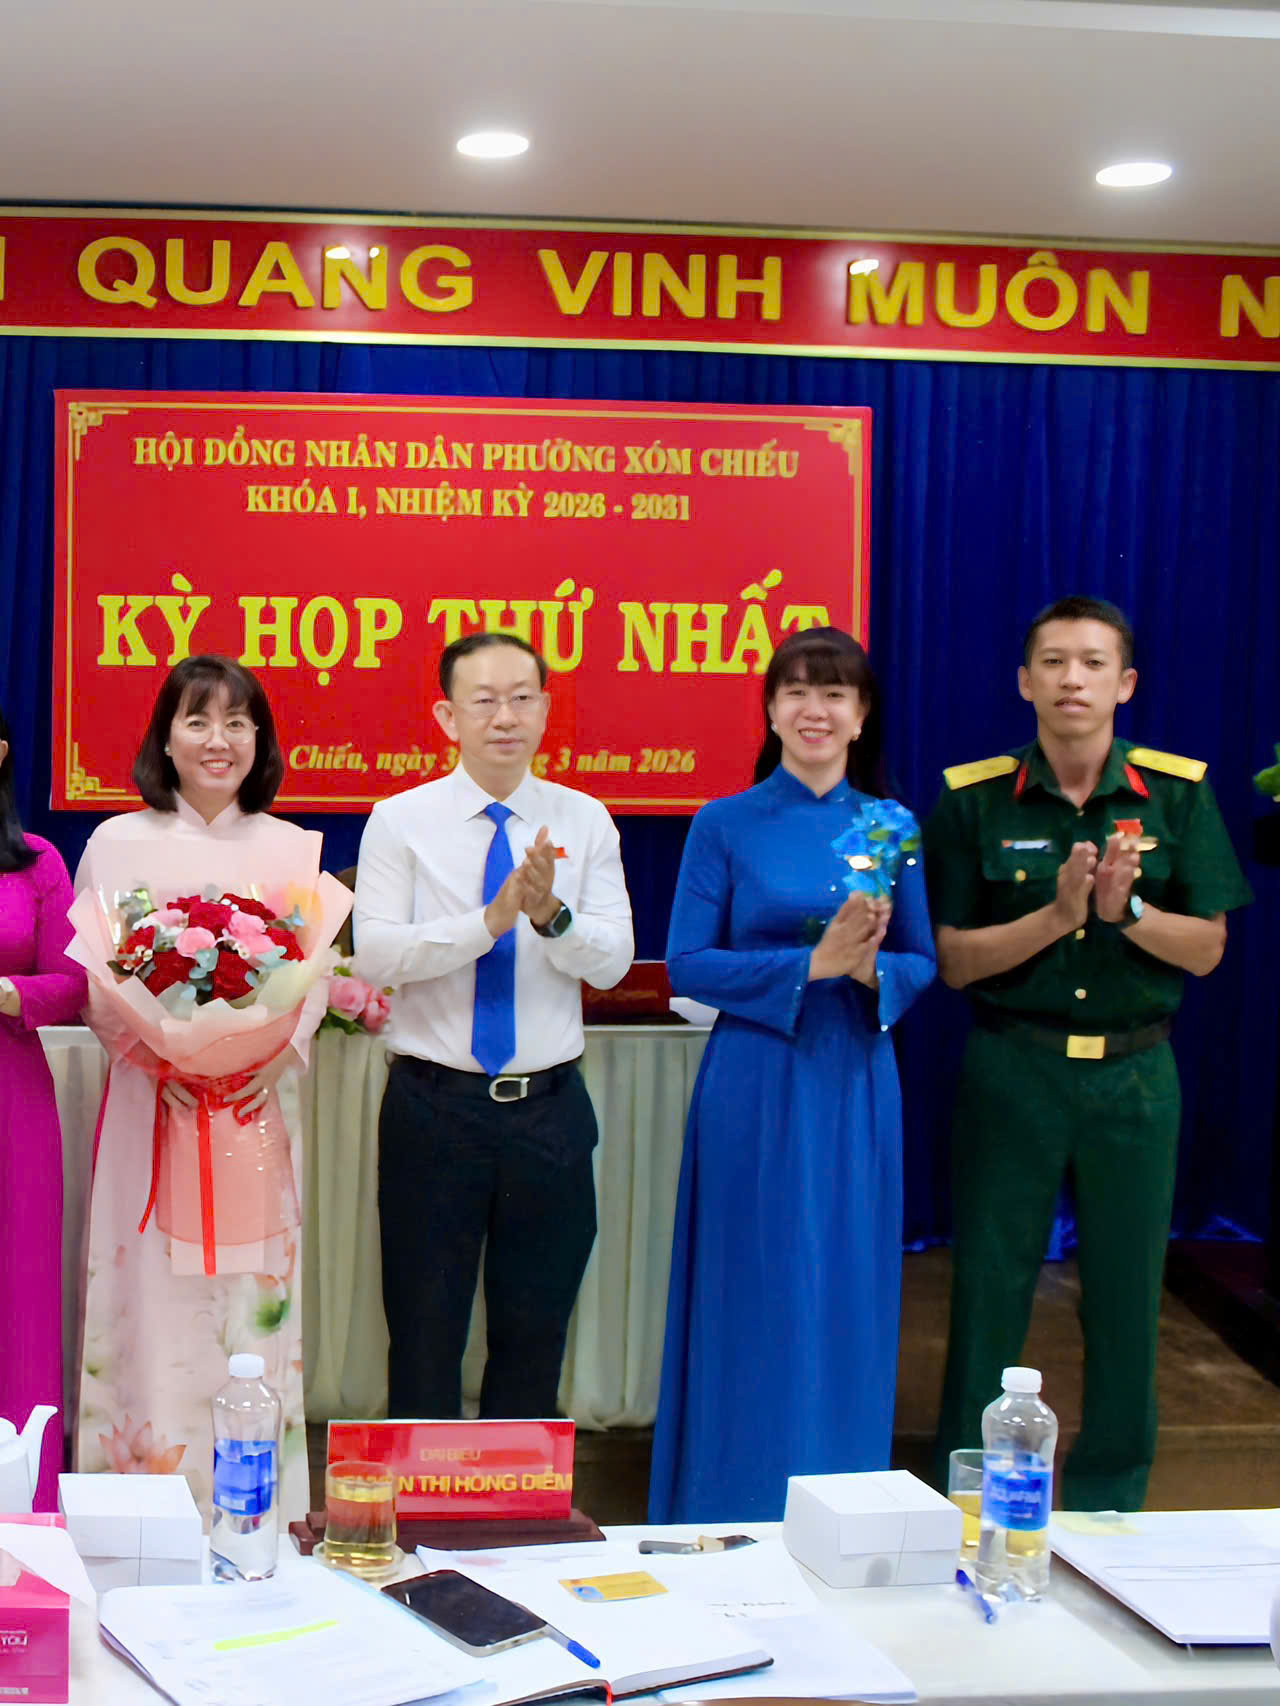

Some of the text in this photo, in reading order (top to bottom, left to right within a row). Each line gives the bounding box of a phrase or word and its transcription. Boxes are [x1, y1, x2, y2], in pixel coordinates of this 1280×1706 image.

[77, 236, 474, 313] QUANG
[538, 249, 783, 321] VINH
[848, 250, 1150, 335] MUÔN
[134, 430, 194, 471] HỘI
[305, 433, 398, 468] NHÂN
[405, 434, 474, 469] DÂN
[482, 438, 616, 473] PHƯỜNG
[623, 440, 692, 475] XÓM
[700, 438, 799, 479] CHIẾU
[246, 478, 338, 514] KHÓA
[347, 486, 368, 520] I,
[376, 480, 482, 522] NHIỆM
[492, 481, 535, 517] KỲ
[543, 491, 607, 518] 2026
[631, 493, 690, 521] 2031
[97, 573, 211, 667] KỲ
[238, 595, 403, 686] HỌP
[428, 578, 594, 673] THỨ
[636, 747, 696, 773] 2026
